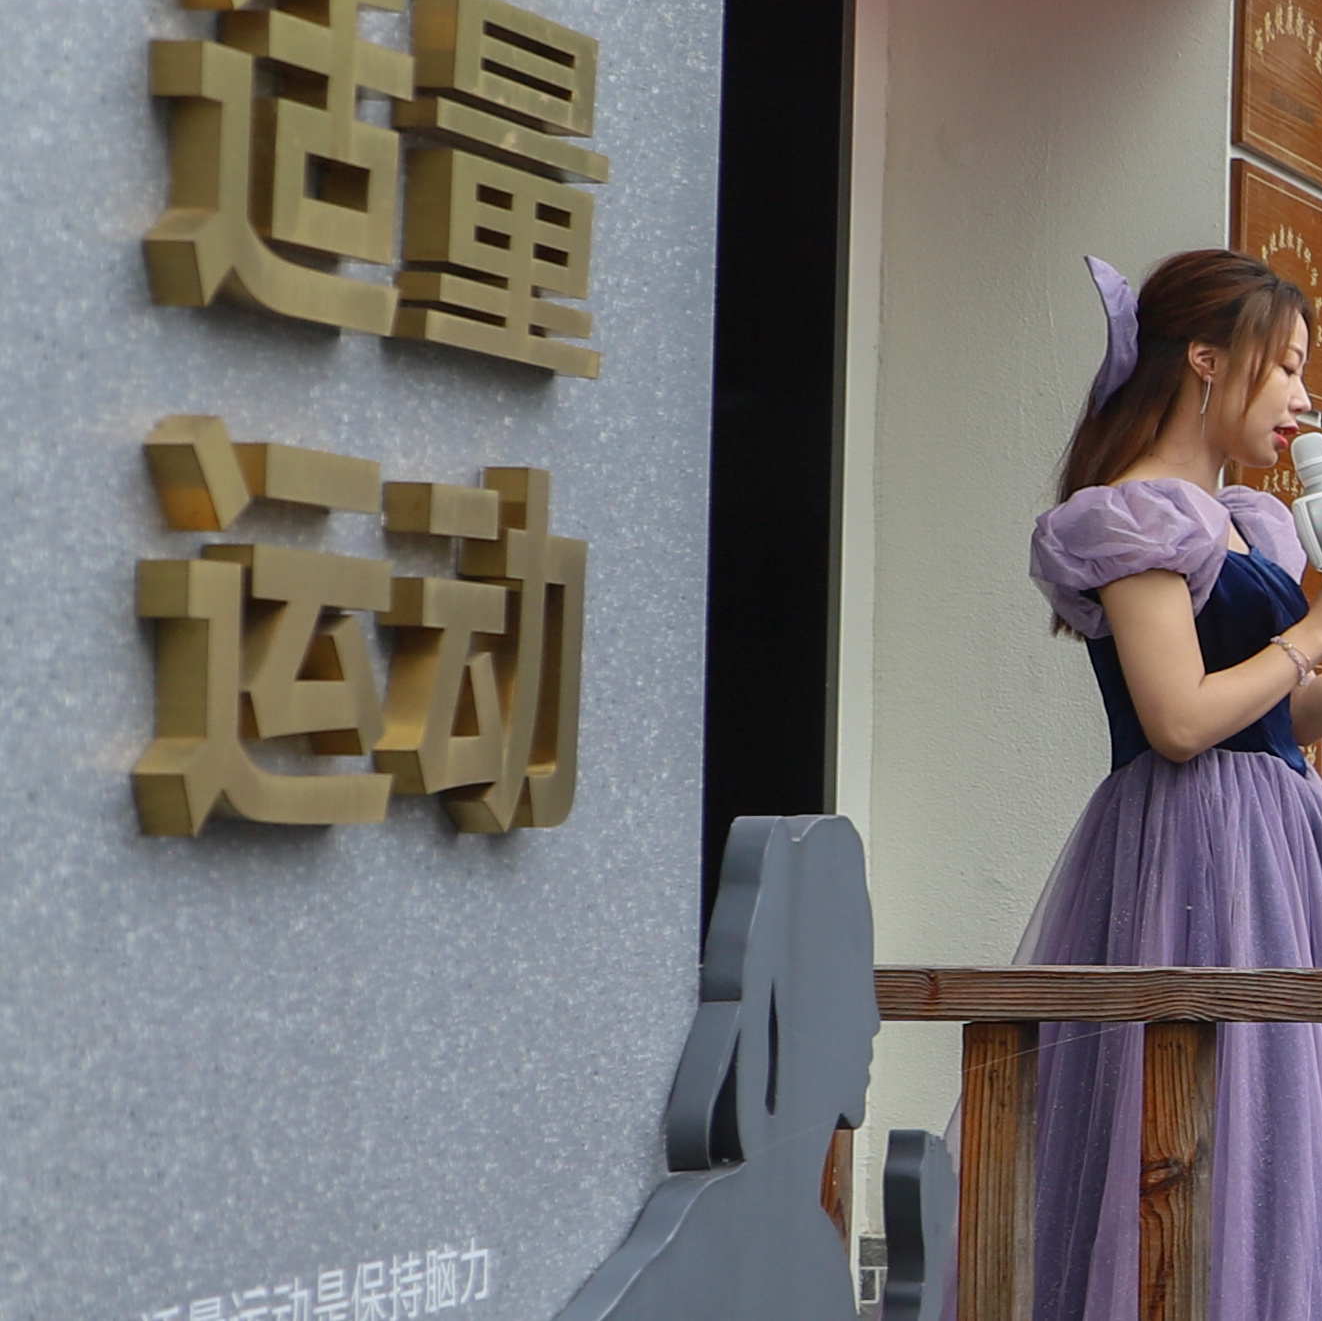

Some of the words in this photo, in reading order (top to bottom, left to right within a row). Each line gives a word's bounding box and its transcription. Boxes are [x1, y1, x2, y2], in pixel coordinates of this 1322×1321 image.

[131, 415, 589, 836] 运动
[140, 1236, 491, 1321] 运动是保持脑力
